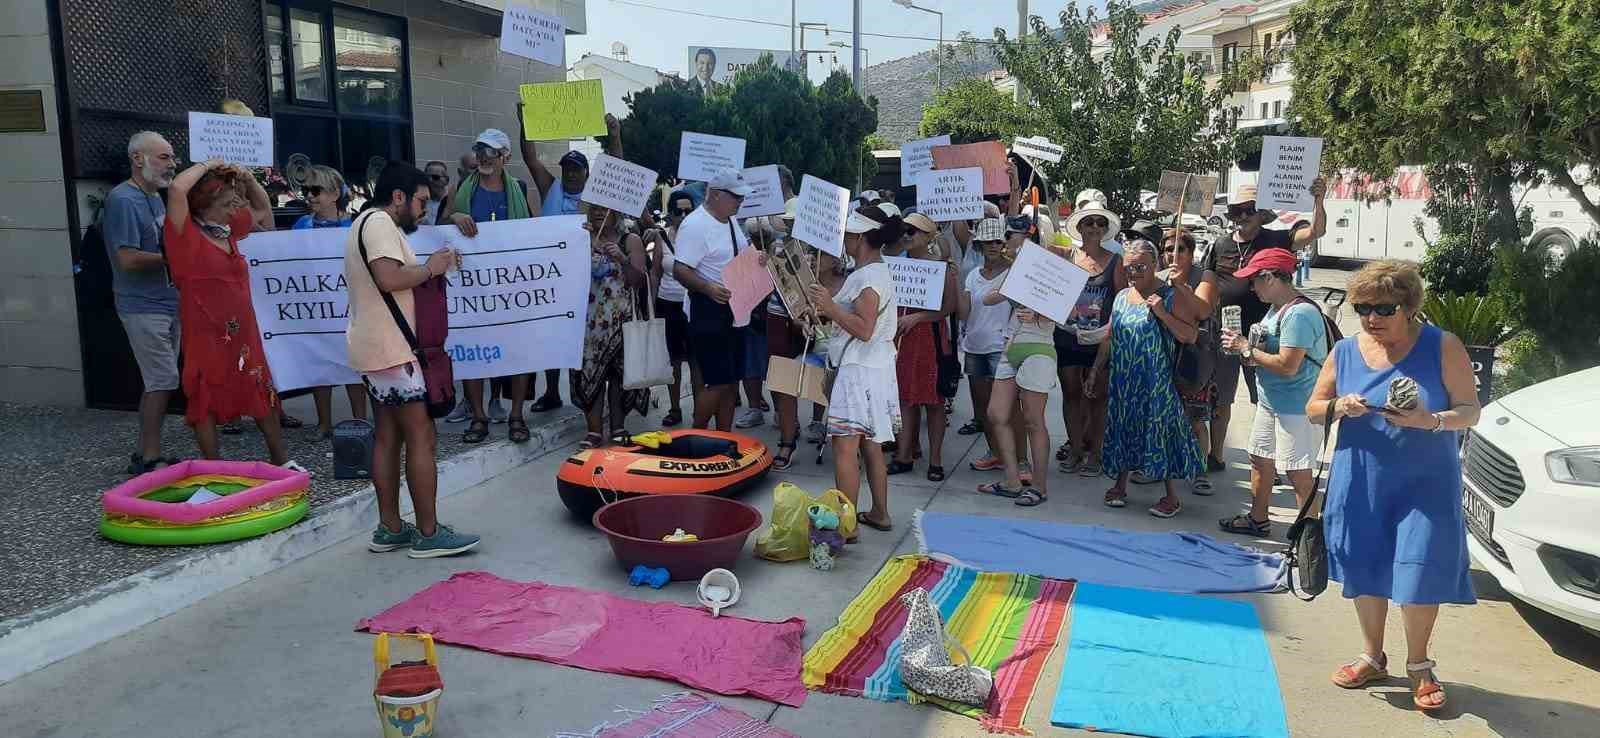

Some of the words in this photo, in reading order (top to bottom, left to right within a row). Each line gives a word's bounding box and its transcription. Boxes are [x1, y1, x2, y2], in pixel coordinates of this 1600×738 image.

[938, 175, 965, 184] ARTIK
[934, 184, 966, 195] DENİZE
[920, 194, 983, 206] GİREMEYECEK
[952, 205, 976, 215] ANNE
[887, 262, 940, 275] EZLONGSUZ
[263, 273, 349, 295] DALKA
[459, 261, 563, 287] BURADA
[908, 276, 927, 285] YER
[895, 285, 927, 296] ULDUM
[447, 287, 557, 316] UNUYOR!
[447, 343, 502, 364] zDatça
[659, 460, 728, 472] EXPLORER
